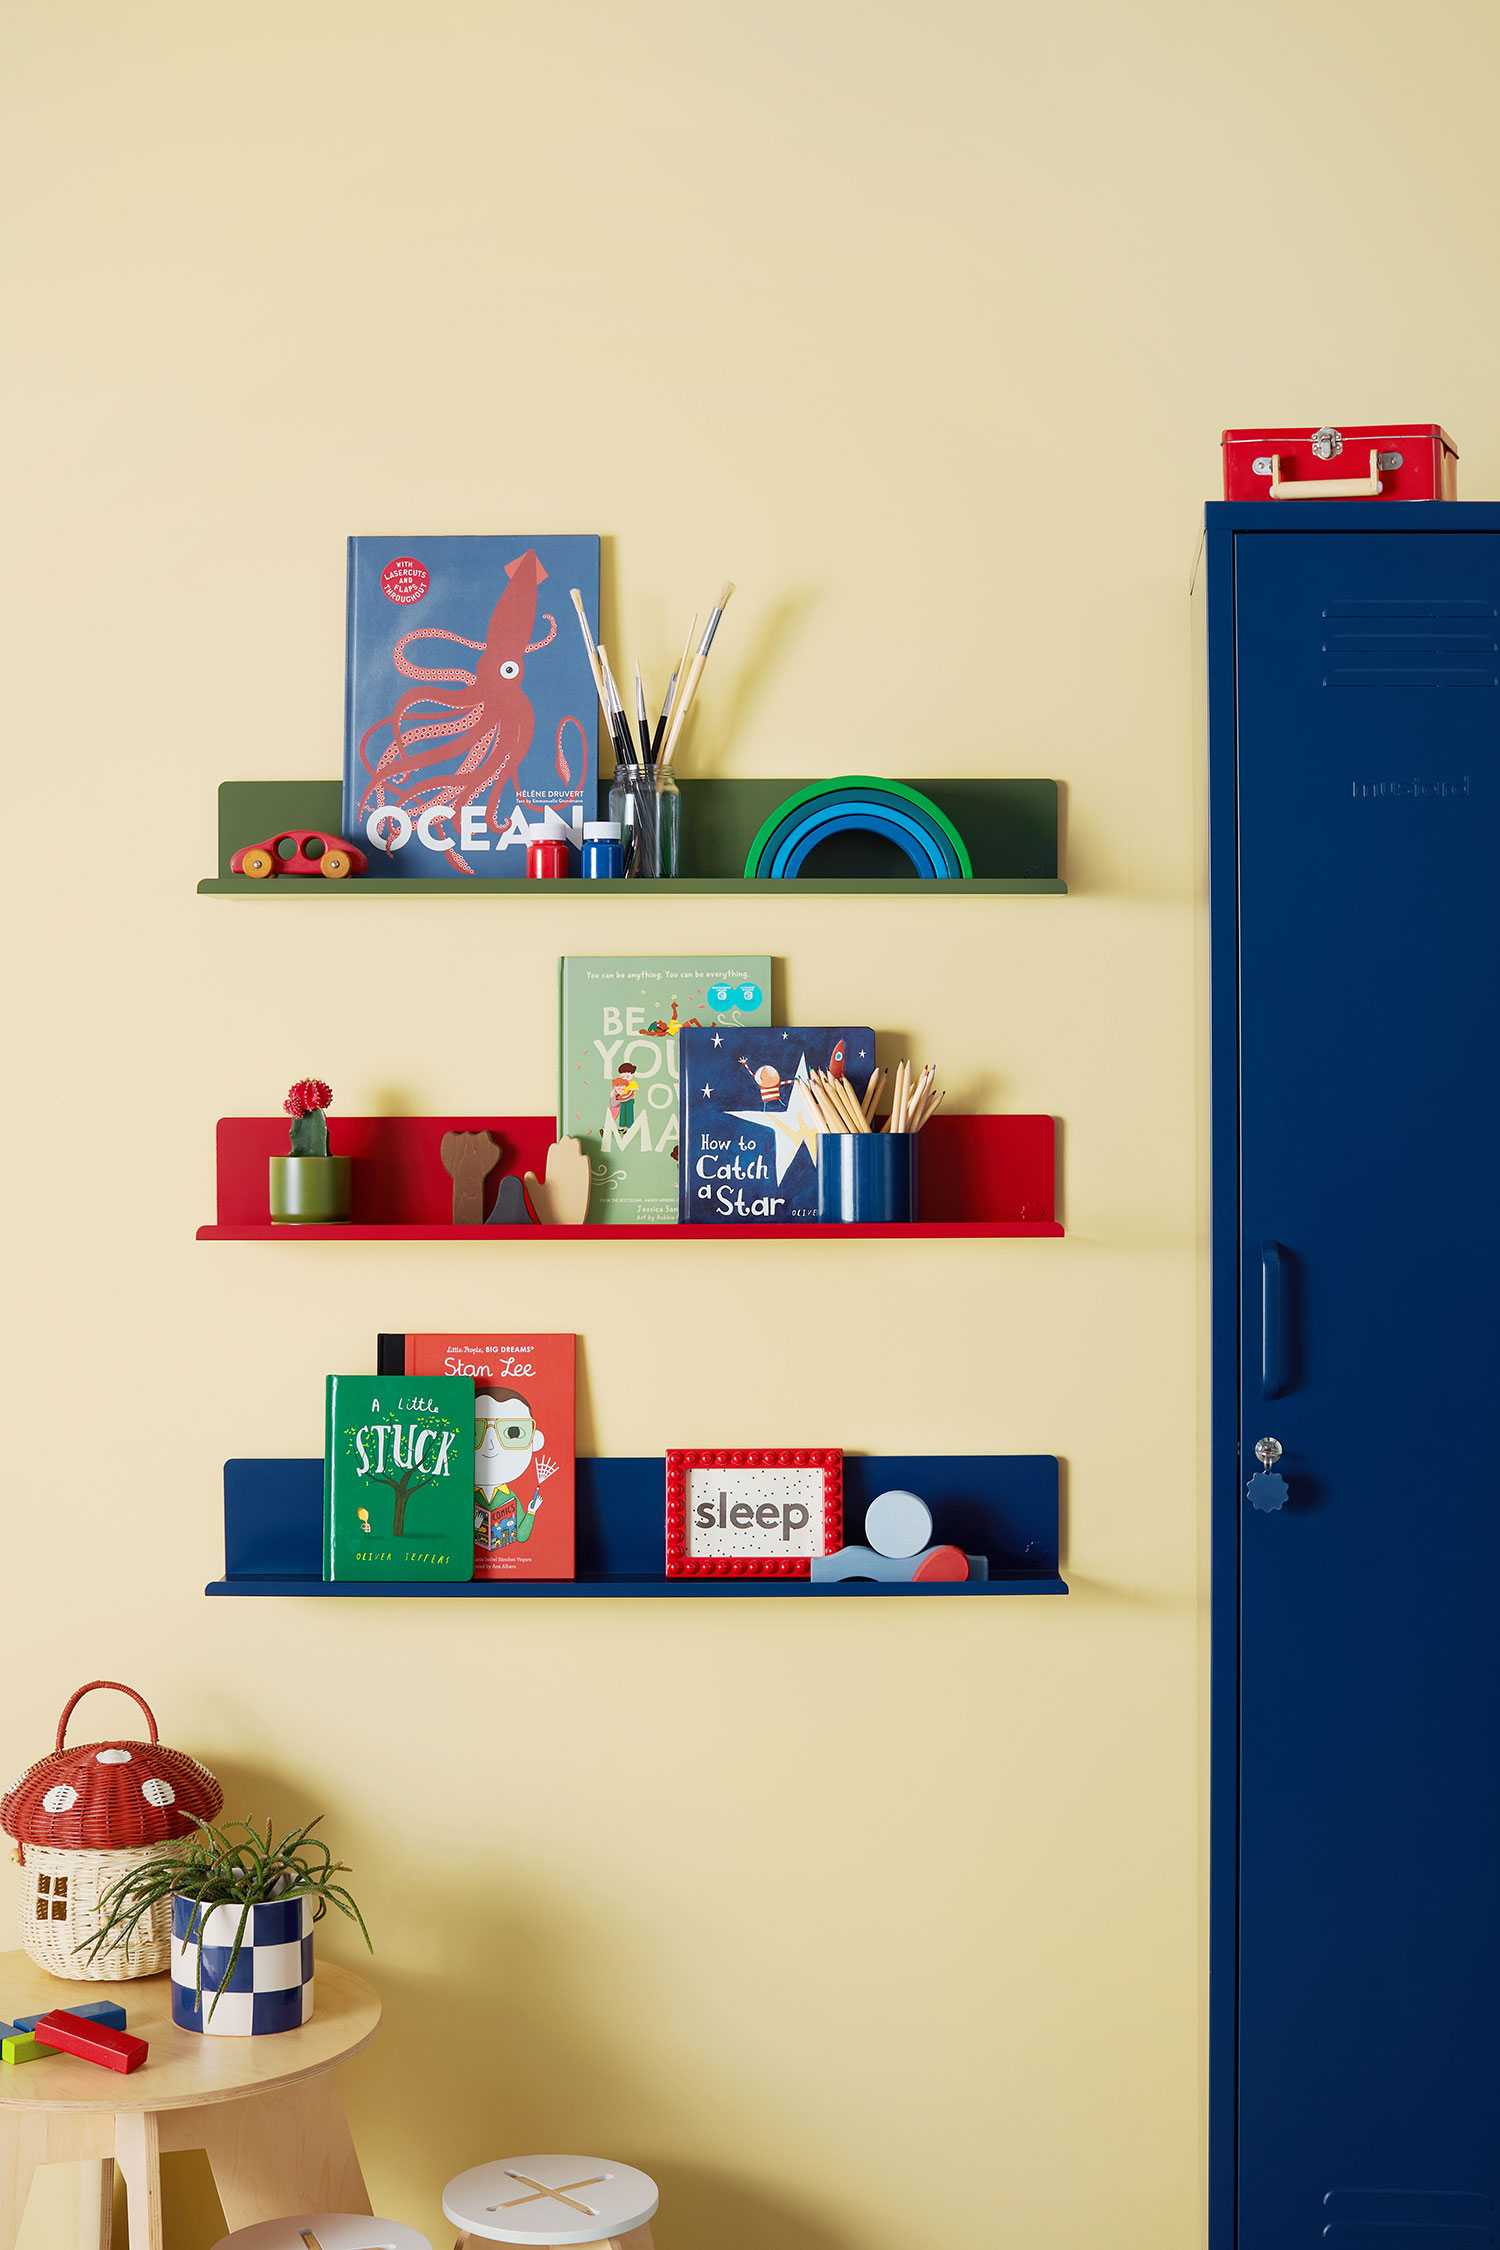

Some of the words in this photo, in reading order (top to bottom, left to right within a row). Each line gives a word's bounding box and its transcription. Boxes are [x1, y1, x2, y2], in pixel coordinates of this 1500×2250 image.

[384, 569, 427, 580] LASERCUTS
[384, 583, 427, 603] THROUGHOUT
[394, 584, 418, 593] FLAPS
[516, 789, 546, 798] HÉLÈNE
[548, 790, 584, 798] DRUVERT
[1352, 775, 1470, 798] mustard
[366, 804, 583, 852] OCEAN
[586, 971, 600, 979] You
[616, 971, 625, 979] be
[695, 970, 704, 978] be
[706, 970, 750, 980] everything.
[603, 1007, 645, 1036] BE
[593, 1039, 679, 1080] YOU
[601, 1108, 679, 1152] MA
[701, 1133, 732, 1150] How
[738, 1135, 757, 1151] to
[696, 1154, 769, 1180] Catch
[637, 1205, 663, 1213] Jessica
[666, 1205, 679, 1213] San
[697, 1184, 711, 1199] a
[716, 1184, 785, 1217] Star
[791, 1208, 817, 1217] OLIVE
[444, 1357, 493, 1377] Stan
[499, 1356, 536, 1377] Lee
[371, 1398, 380, 1412] A
[398, 1397, 439, 1413] Little
[356, 1424, 455, 1477] STUCK
[492, 1503, 516, 1521] COMICS
[696, 1491, 809, 1541] sleep
[356, 1552, 392, 1561] OLIVER
[405, 1553, 450, 1564] JEFFERS
